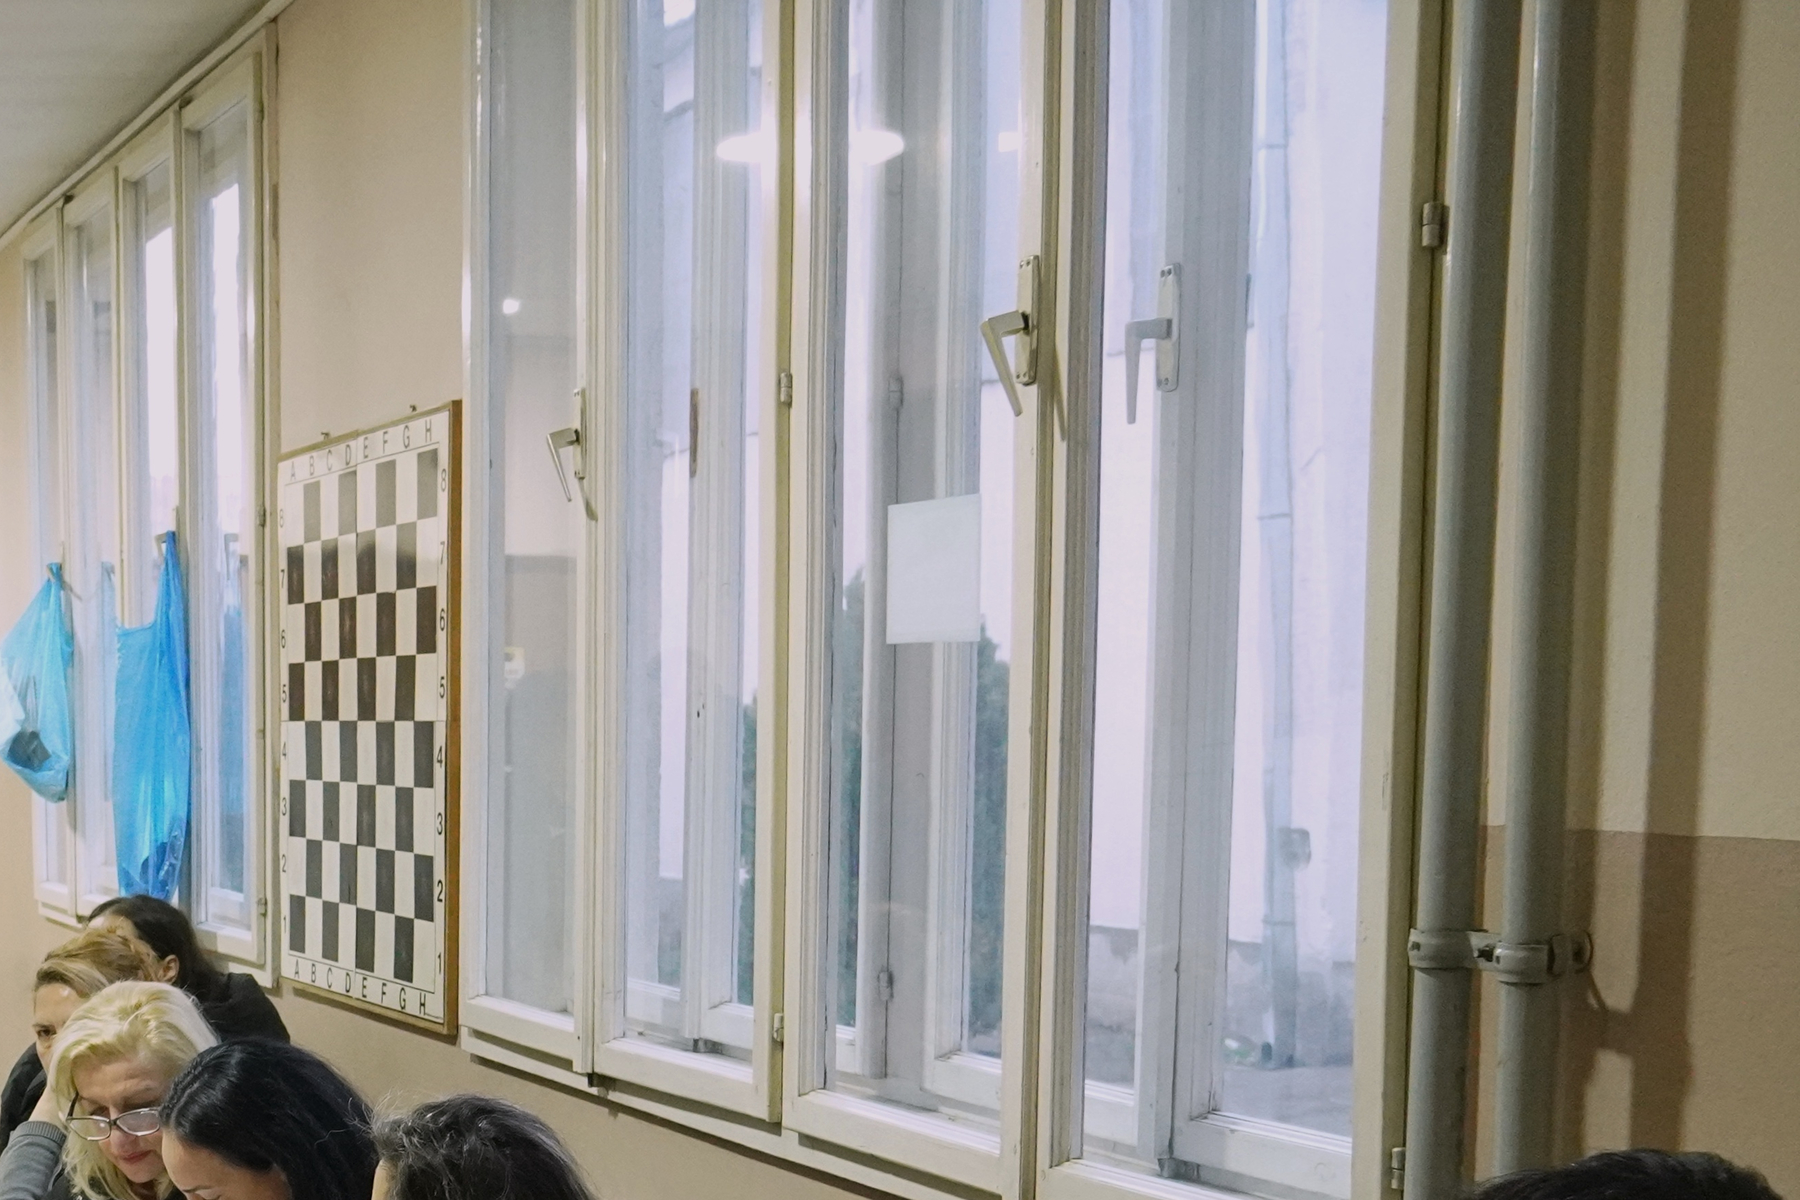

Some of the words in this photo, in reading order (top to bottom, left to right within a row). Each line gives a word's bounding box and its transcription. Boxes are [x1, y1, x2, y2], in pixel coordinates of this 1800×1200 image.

[290, 460, 296, 481] A
[309, 456, 315, 476] B
[326, 449, 333, 471] C
[345, 444, 351, 466] D
[363, 436, 369, 460] E
[382, 431, 388, 454] F
[402, 425, 410, 450] G
[424, 418, 432, 443] H
[440, 468, 447, 492] 8
[279, 508, 284, 528] 8
[440, 541, 446, 565] 7
[280, 569, 286, 589] 7
[439, 608, 446, 632] 6
[280, 629, 286, 649] 6
[282, 684, 287, 703] 5
[439, 676, 446, 699] 5
[282, 741, 287, 760] 4
[436, 745, 444, 768] 4
[281, 797, 287, 816] 3
[436, 812, 443, 836] 3
[282, 854, 287, 873] 2
[437, 879, 444, 902] 2
[294, 958, 300, 979] A
[311, 963, 317, 984] B
[326, 967, 333, 989] C
[345, 972, 351, 993] D
[361, 976, 368, 998] E
[381, 982, 387, 1004] F
[399, 987, 406, 1010] G
[419, 993, 426, 1016] H
